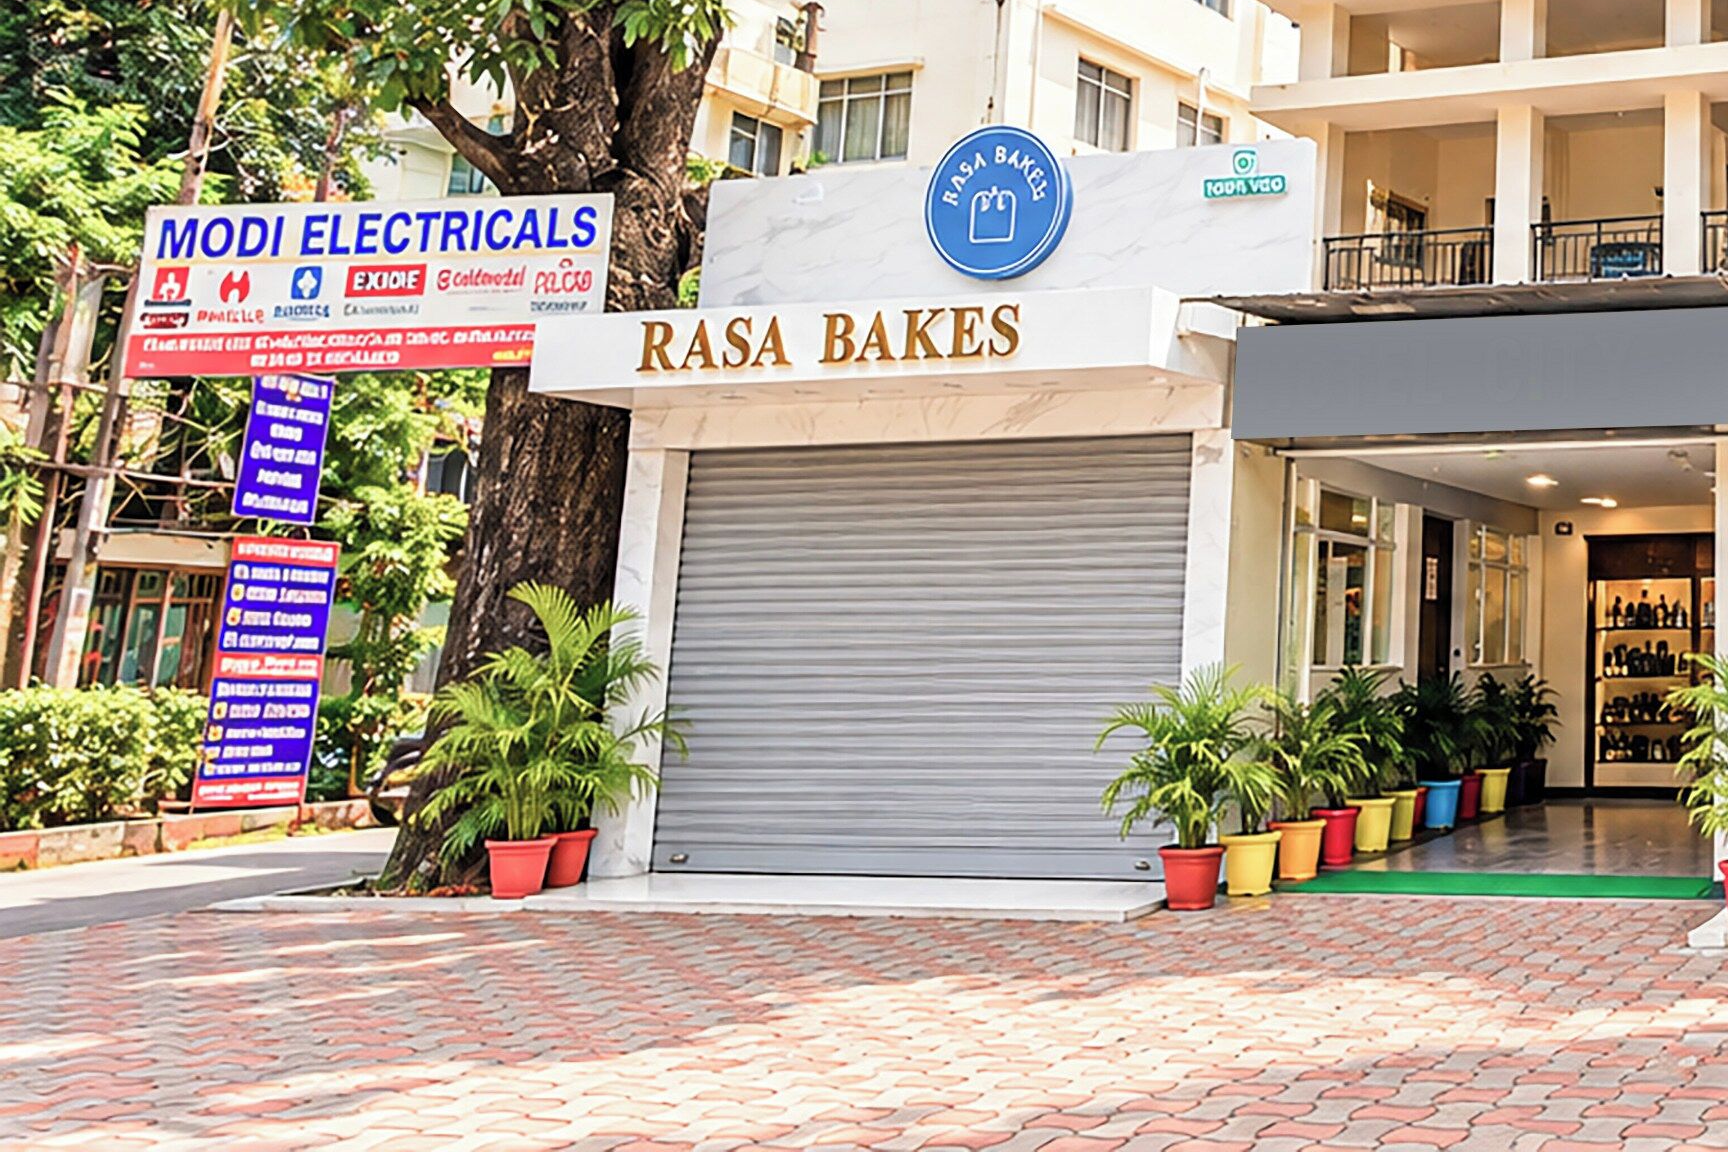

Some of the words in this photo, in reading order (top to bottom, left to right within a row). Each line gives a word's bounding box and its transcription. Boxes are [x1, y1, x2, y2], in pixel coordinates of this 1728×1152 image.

[942, 151, 987, 207] RASA
[155, 216, 284, 260] MODI
[299, 205, 599, 257] ELECTRICALS
[636, 315, 793, 372] RASA
[818, 303, 1021, 364] BAKES
